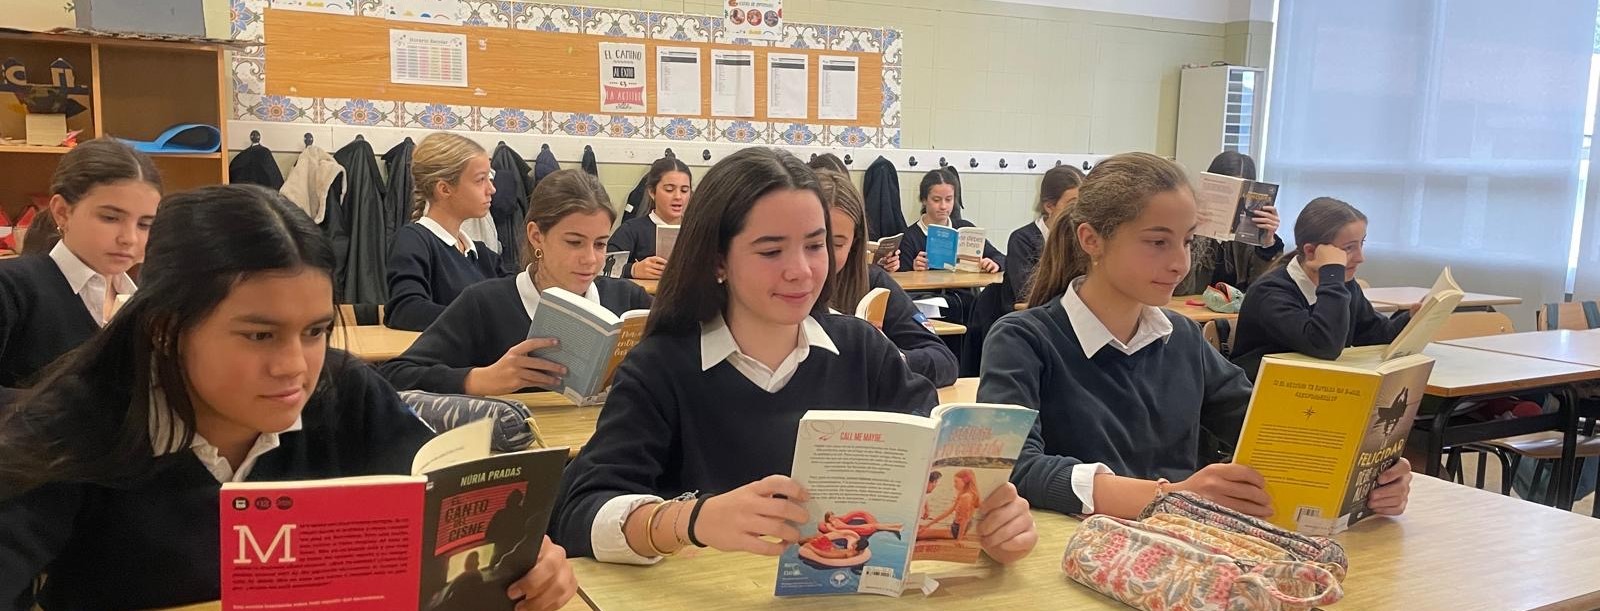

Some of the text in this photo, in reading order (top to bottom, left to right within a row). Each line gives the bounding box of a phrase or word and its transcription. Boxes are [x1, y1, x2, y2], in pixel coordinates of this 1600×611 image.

[604, 49, 642, 60] EL CAMINO
[840, 431, 853, 441] CALL
[854, 432, 862, 441] ME
[1357, 438, 1405, 467] FELICIDAD
[488, 466, 522, 481] PRADAS
[445, 499, 489, 522] CANTO
[447, 521, 486, 542] CISNE
